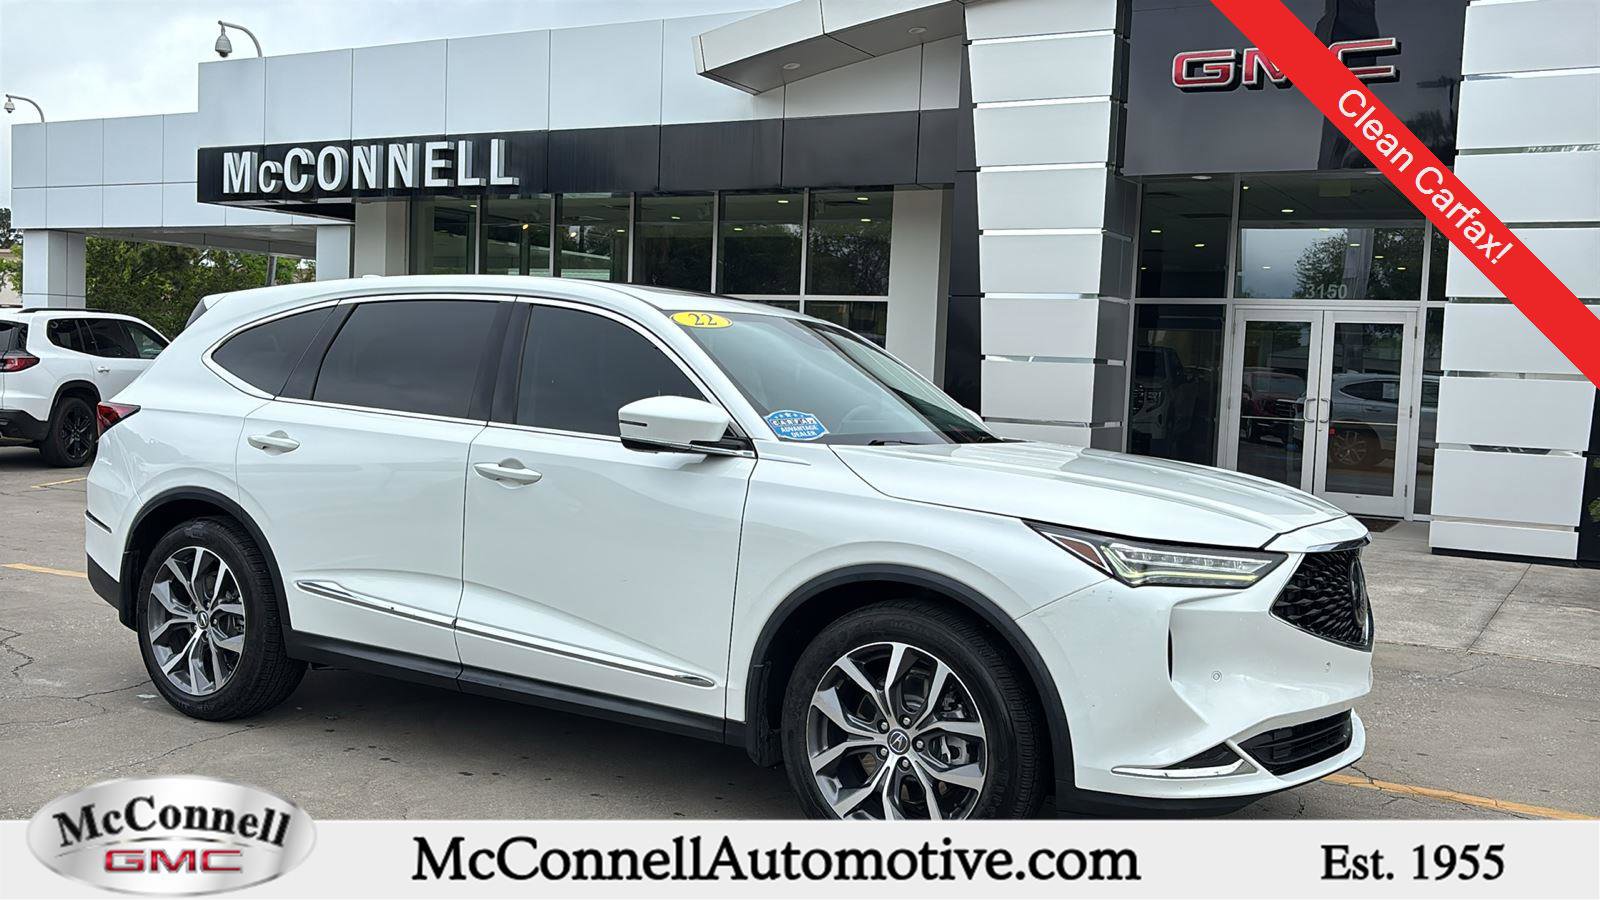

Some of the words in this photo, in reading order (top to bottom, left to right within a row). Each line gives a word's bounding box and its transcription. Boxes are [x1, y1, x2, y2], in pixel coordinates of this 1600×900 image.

[223, 138, 520, 194] McCONNELL
[1305, 283, 1348, 299] 3150
[688, 313, 717, 325] 22
[791, 430, 818, 438] DEALER
